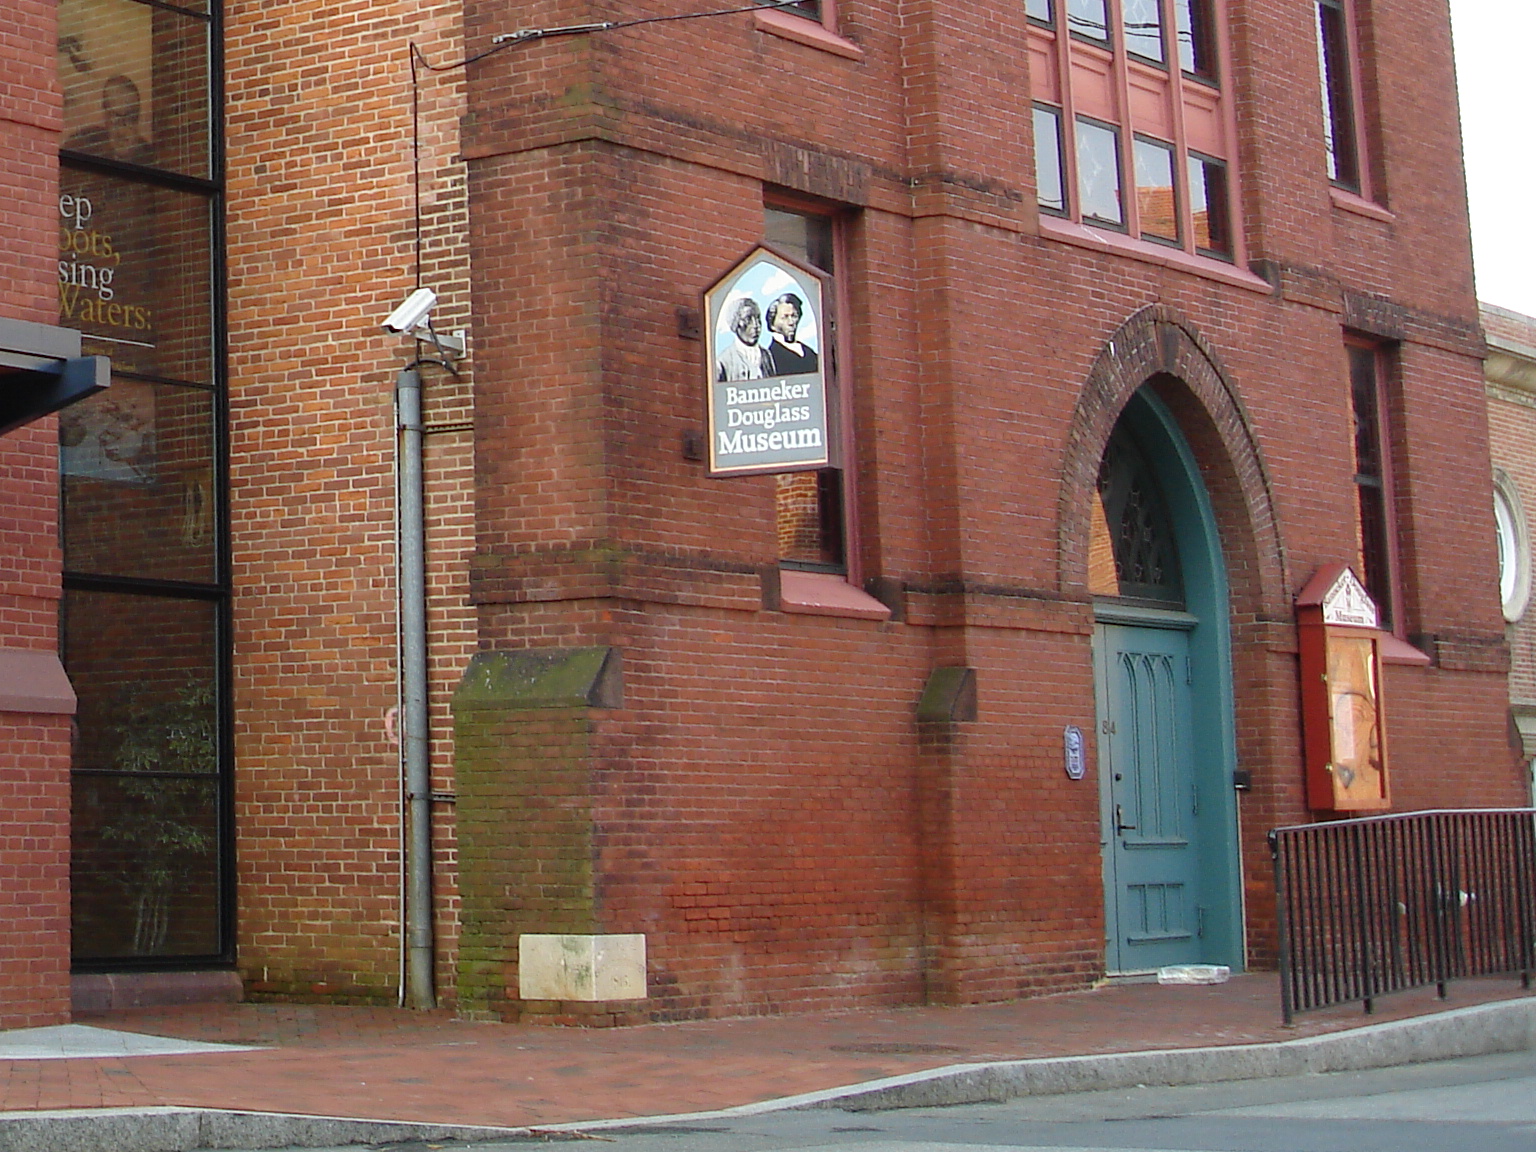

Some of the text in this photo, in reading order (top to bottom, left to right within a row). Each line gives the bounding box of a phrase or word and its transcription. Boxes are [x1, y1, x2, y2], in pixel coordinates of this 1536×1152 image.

[726, 380, 810, 405] Banneker
[727, 404, 810, 429] Douglass
[718, 427, 822, 455] Museum
